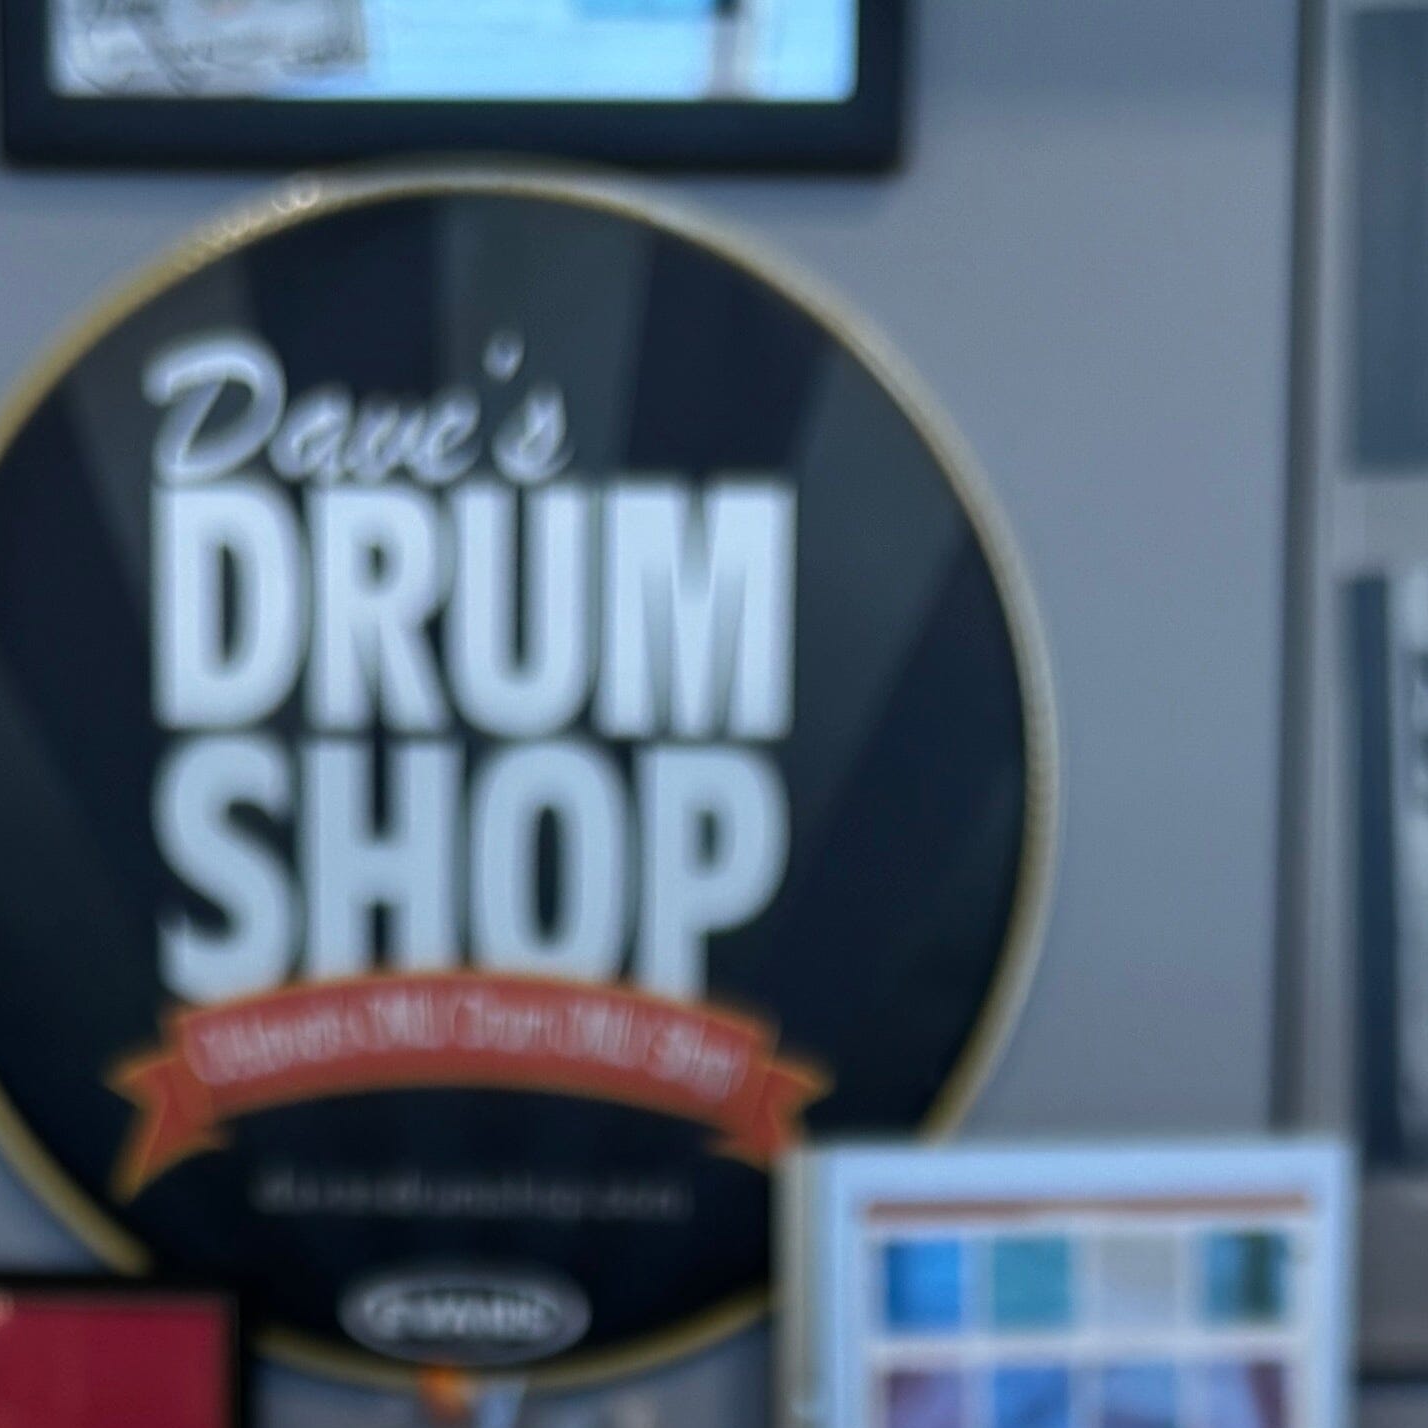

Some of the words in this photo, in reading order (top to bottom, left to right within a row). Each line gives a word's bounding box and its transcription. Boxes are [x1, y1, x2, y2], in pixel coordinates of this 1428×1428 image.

[143, 330, 572, 485] Dave's
[152, 478, 797, 737] DRUM
[153, 734, 790, 1002] SHOP
